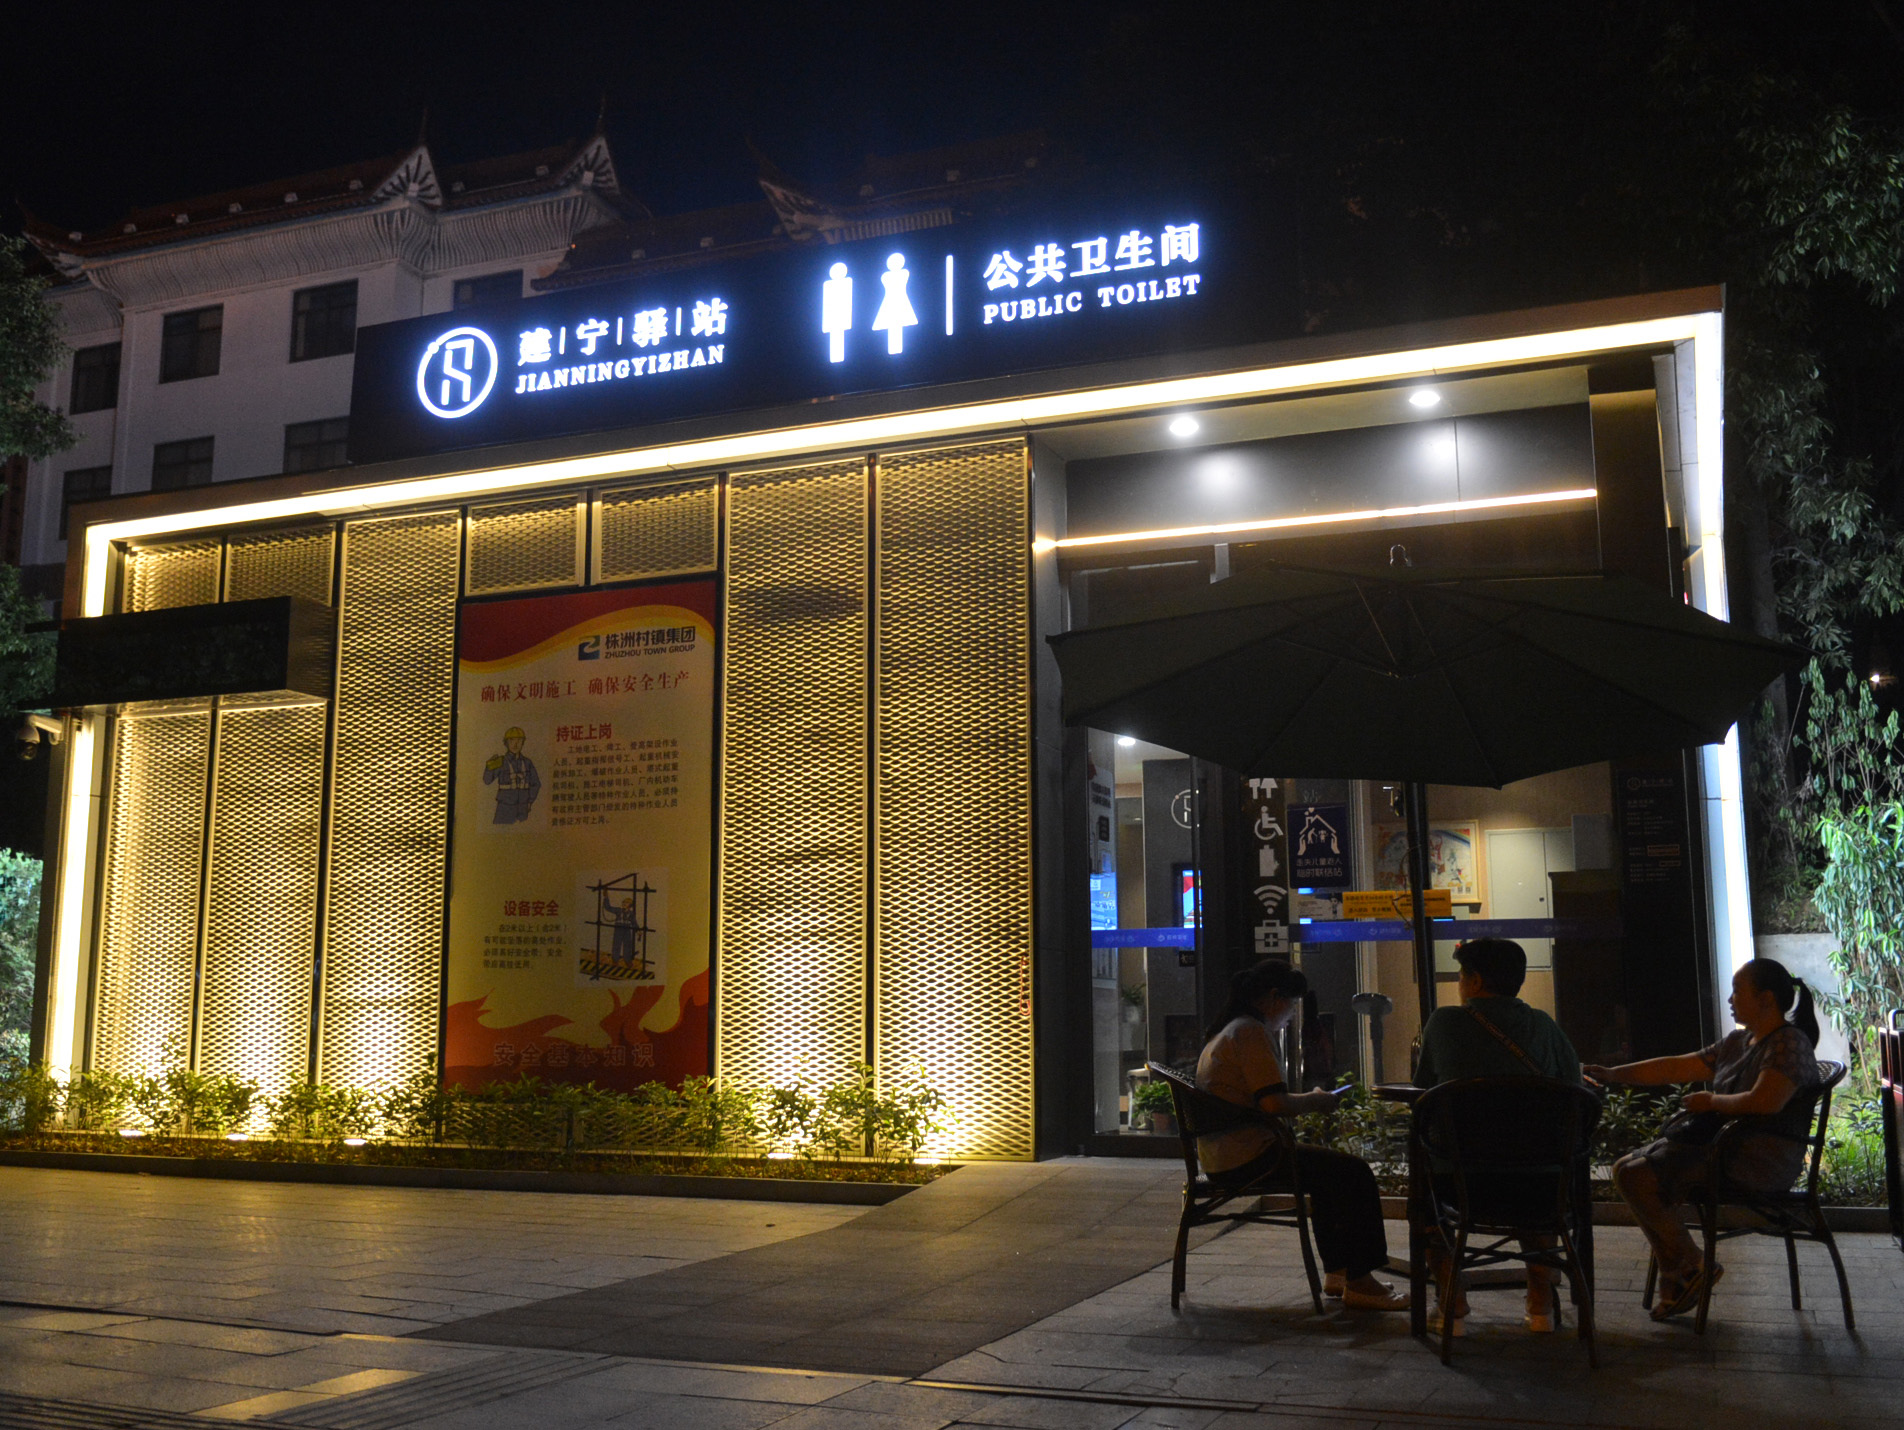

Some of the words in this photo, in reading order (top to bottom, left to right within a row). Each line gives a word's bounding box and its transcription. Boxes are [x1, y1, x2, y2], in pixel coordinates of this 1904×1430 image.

[983, 223, 1199, 291] 公共卫生间
[983, 292, 1082, 325] PUBLIC
[1097, 274, 1201, 307] TOILET
[515, 344, 725, 394] JIANNINGYIZHAN
[604, 649, 642, 659] ZHUZHOU
[644, 647, 667, 655] TOWN
[669, 644, 696, 653] GROUP
[605, 626, 696, 650] 株洲村镇集团
[481, 679, 577, 702] 确保文明施工
[588, 670, 690, 695] 确保安全生产
[556, 723, 612, 742] 持证上岗
[504, 899, 560, 918] 设备安全
